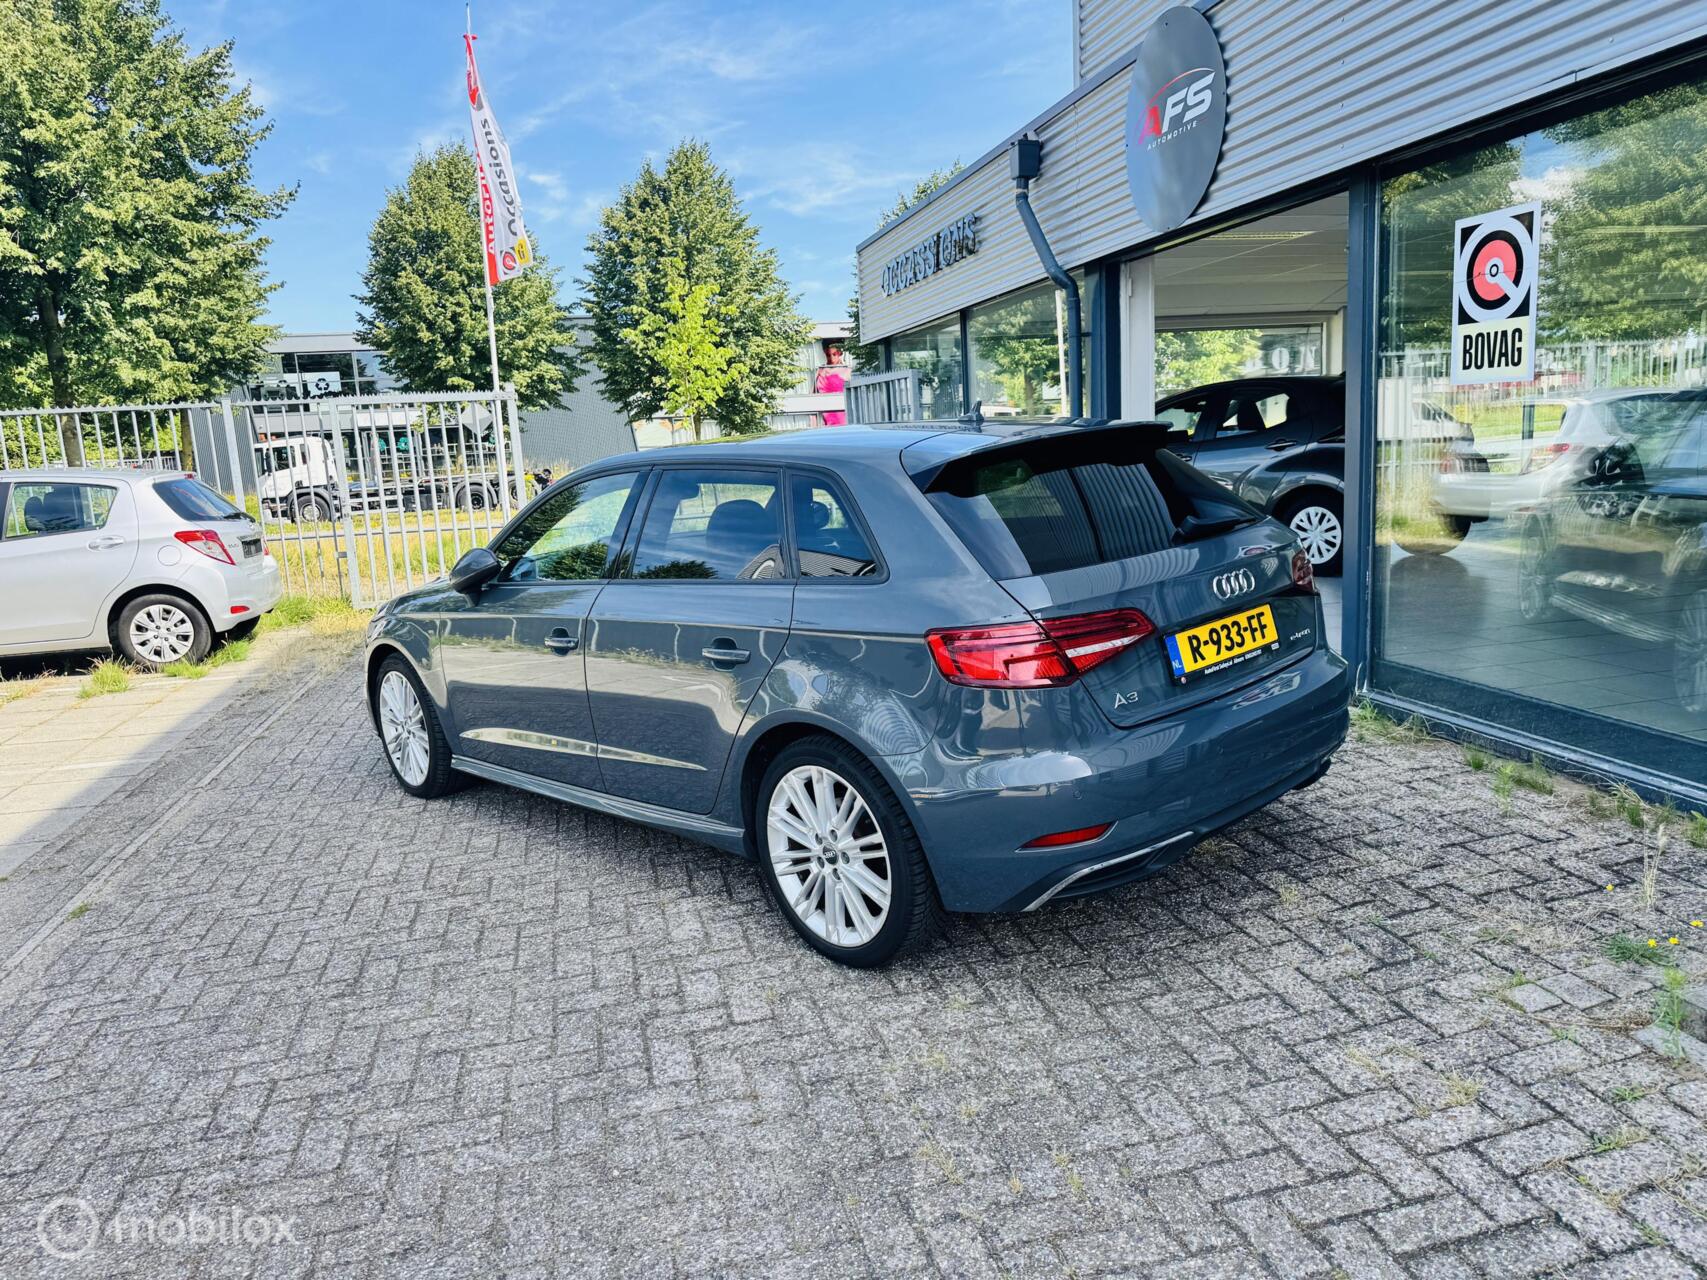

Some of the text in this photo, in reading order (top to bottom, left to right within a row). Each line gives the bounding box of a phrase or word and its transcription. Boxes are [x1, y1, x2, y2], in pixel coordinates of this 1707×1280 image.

[1139, 71, 1215, 145] AFS
[1147, 120, 1198, 150] AUTOMOTIVE
[1462, 328, 1523, 370] BOVAG
[1187, 611, 1268, 664] R-933-FF
[1113, 692, 1139, 709] A3
